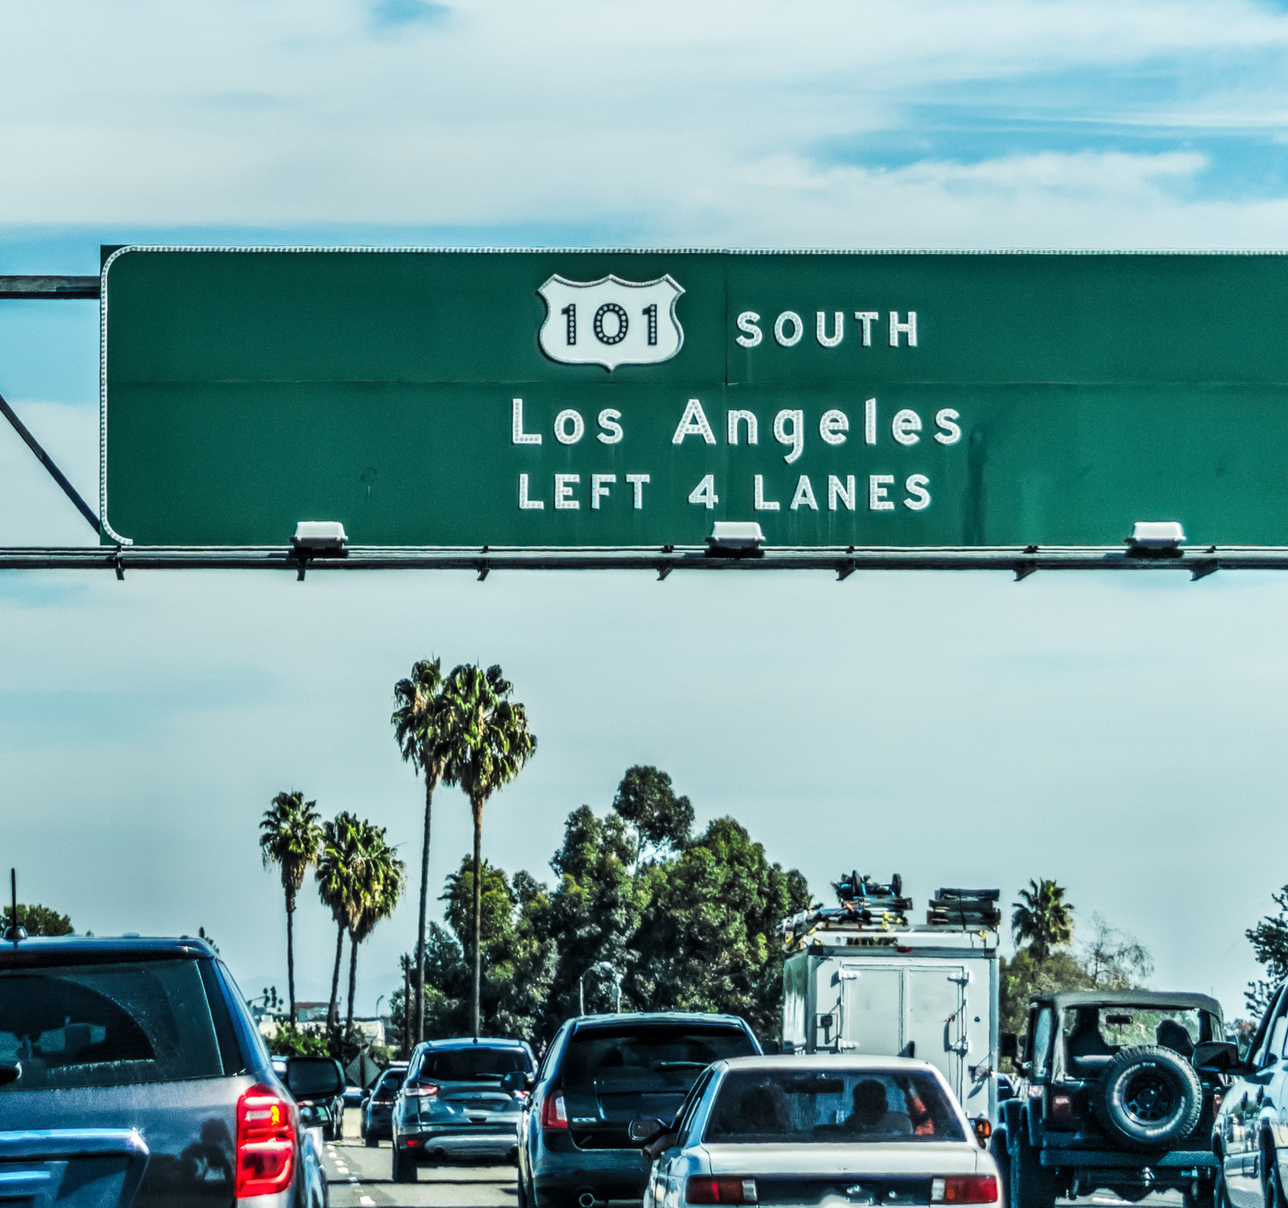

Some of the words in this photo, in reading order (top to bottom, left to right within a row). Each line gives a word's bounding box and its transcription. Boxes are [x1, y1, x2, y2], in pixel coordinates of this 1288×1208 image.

[561, 303, 659, 346] 101
[736, 312, 918, 347] SOUTH
[513, 399, 624, 445] Los
[673, 398, 962, 463] Angeles
[519, 474, 650, 510] LEFT
[688, 474, 719, 510] 4
[754, 474, 932, 510] LANES
